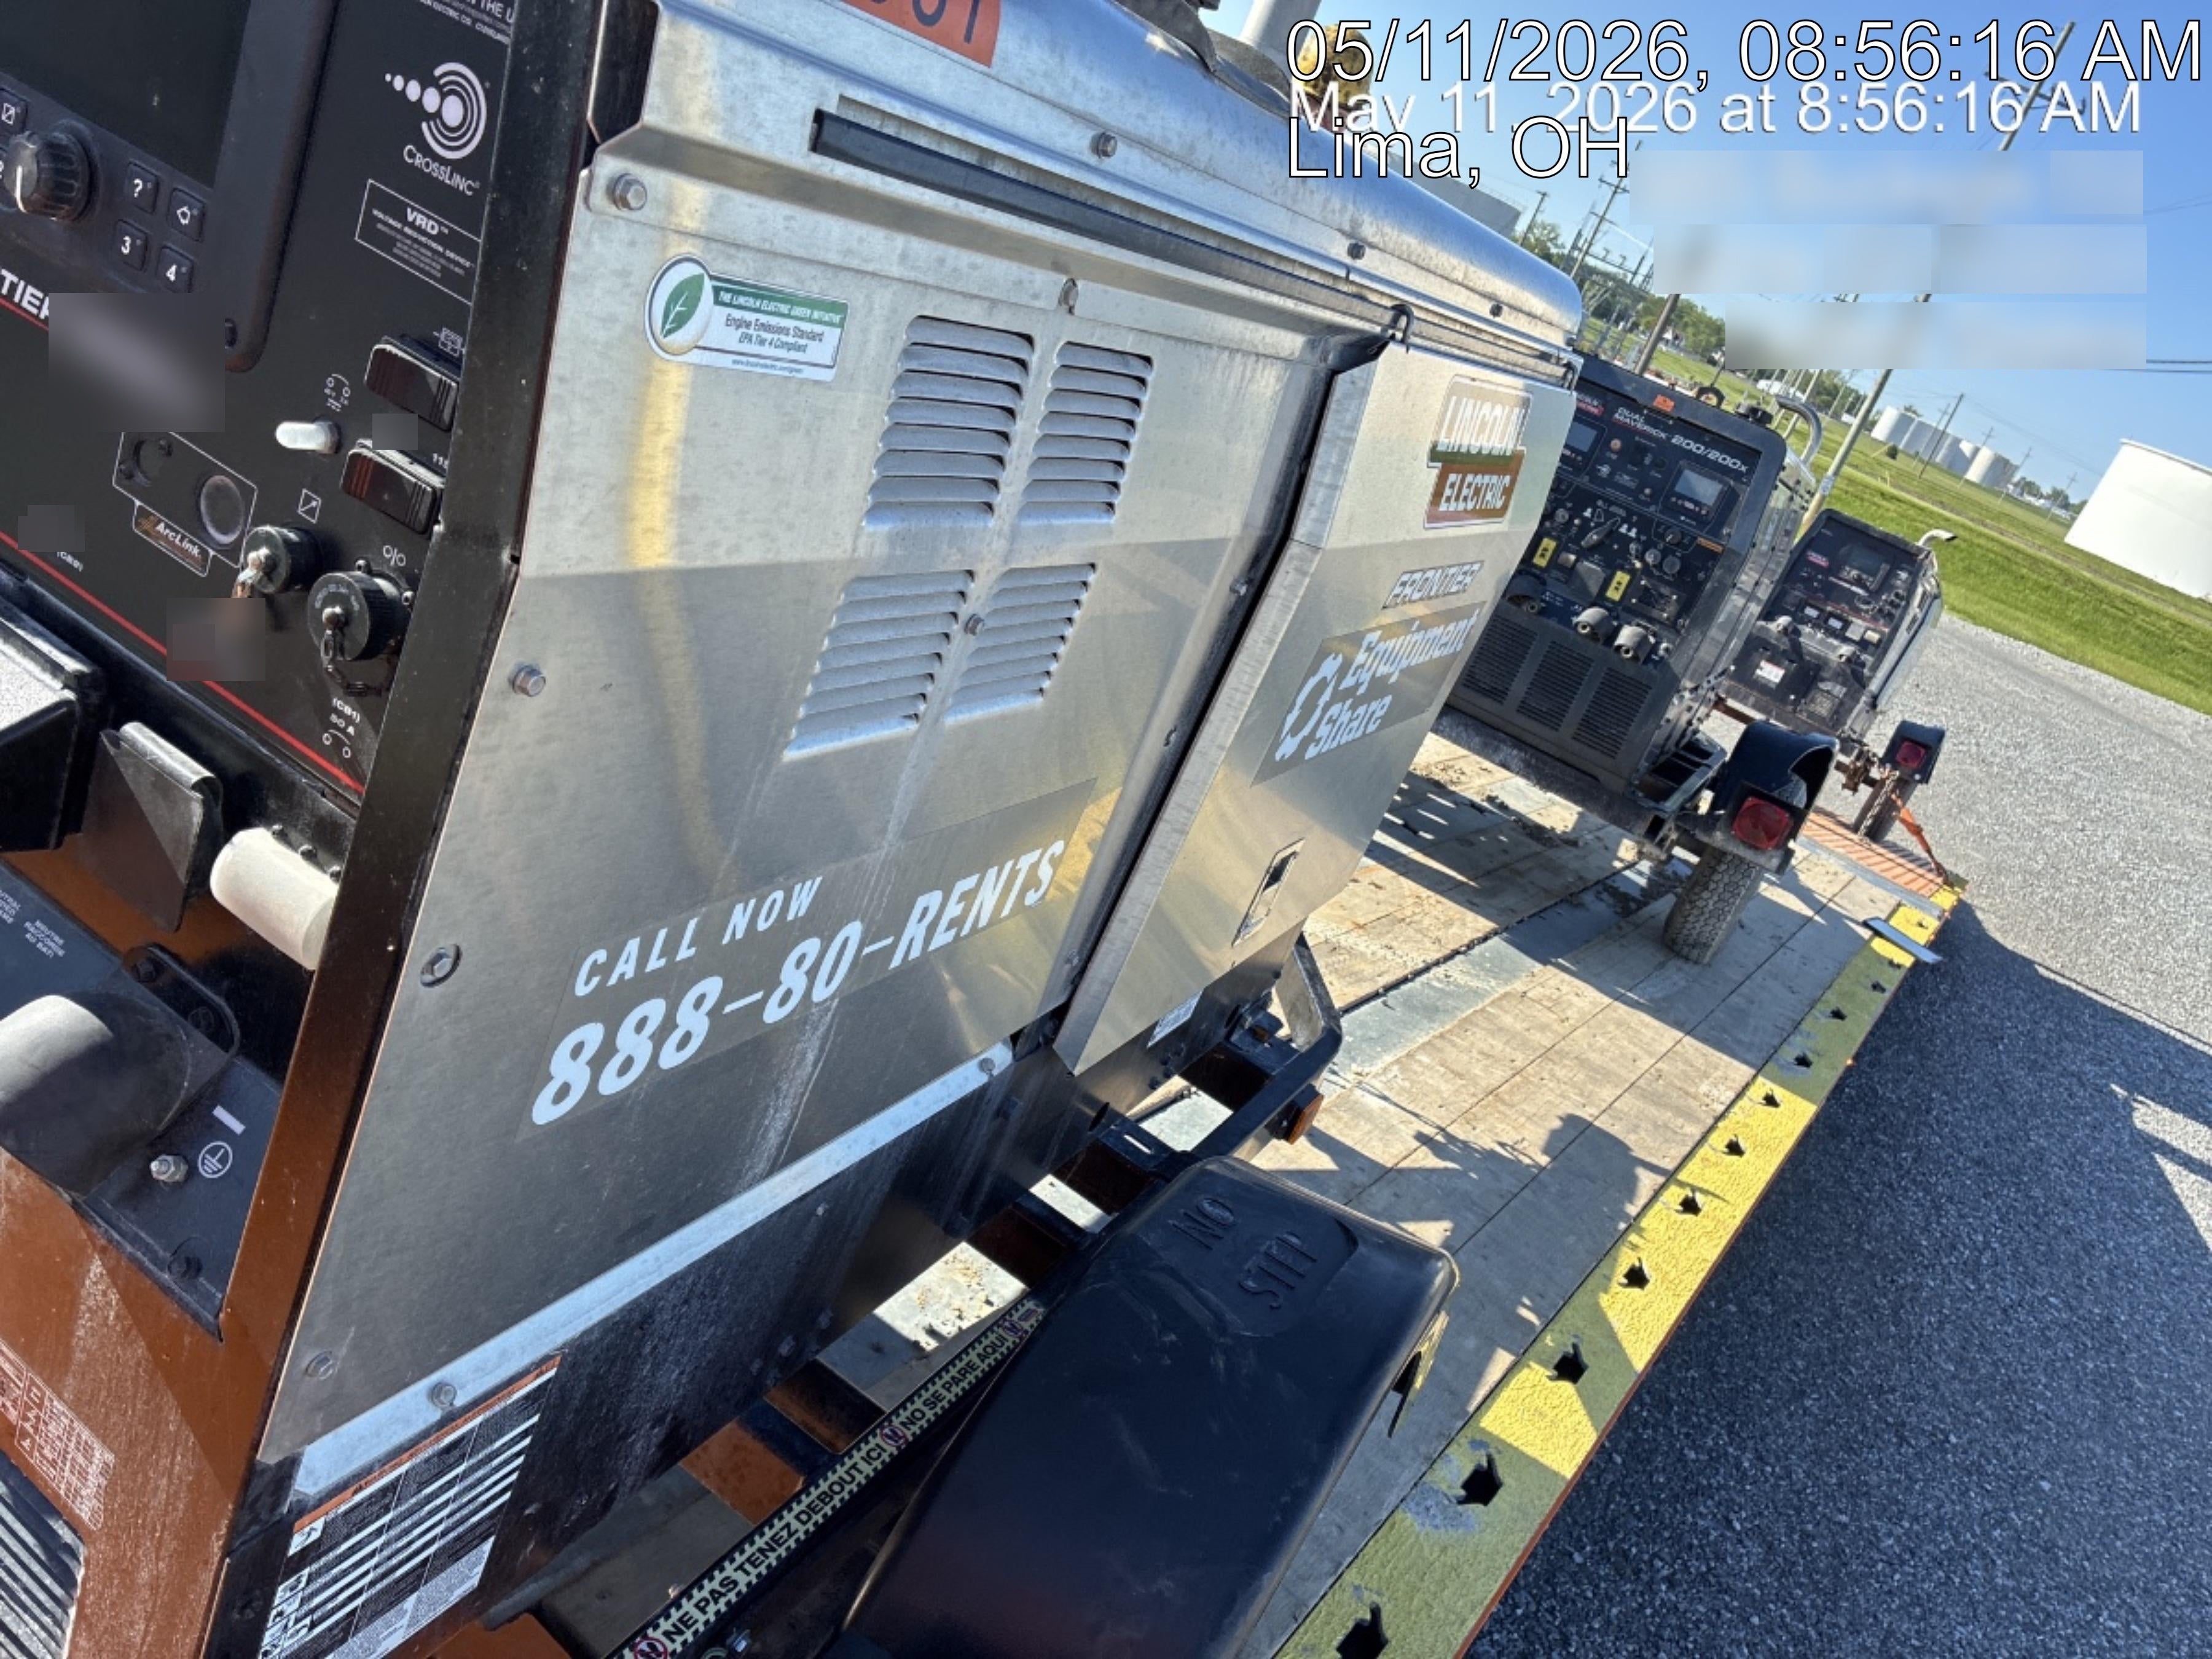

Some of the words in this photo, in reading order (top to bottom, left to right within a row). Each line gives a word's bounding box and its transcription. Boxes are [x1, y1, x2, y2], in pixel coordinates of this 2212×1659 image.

[120, 235, 131, 255] 3
[165, 264, 177, 282] 4
[726, 313, 752, 331] Engine
[754, 318, 791, 337] Emissions
[792, 325, 824, 342] Standard
[739, 331, 753, 344] EPA
[755, 334, 767, 347] Tier
[768, 337, 774, 349] 4
[774, 337, 808, 354] Compliant
[1437, 396, 1525, 456] LINCOLN
[1439, 473, 1511, 511] ELECTRIC
[1383, 562, 1483, 607] FRONTIER
[1338, 608, 1480, 696] Equipment
[1304, 694, 1392, 761] Share
[575, 917, 701, 997] CALL
[722, 876, 823, 946] NOW
[532, 840, 1065, 1125] 888-80-RENTS
[1168, 1198, 1237, 1251] NO
[900, 1406, 927, 1430] NO
[924, 1389, 947, 1411] SE
[944, 1359, 981, 1393] PARE
[661, 1611, 699, 1644] NE
[693, 1575, 739, 1615] PAS
[733, 1522, 799, 1577] TENEZ
[794, 1464, 864, 1527] DEBOUT
[861, 1443, 888, 1466] ICI
